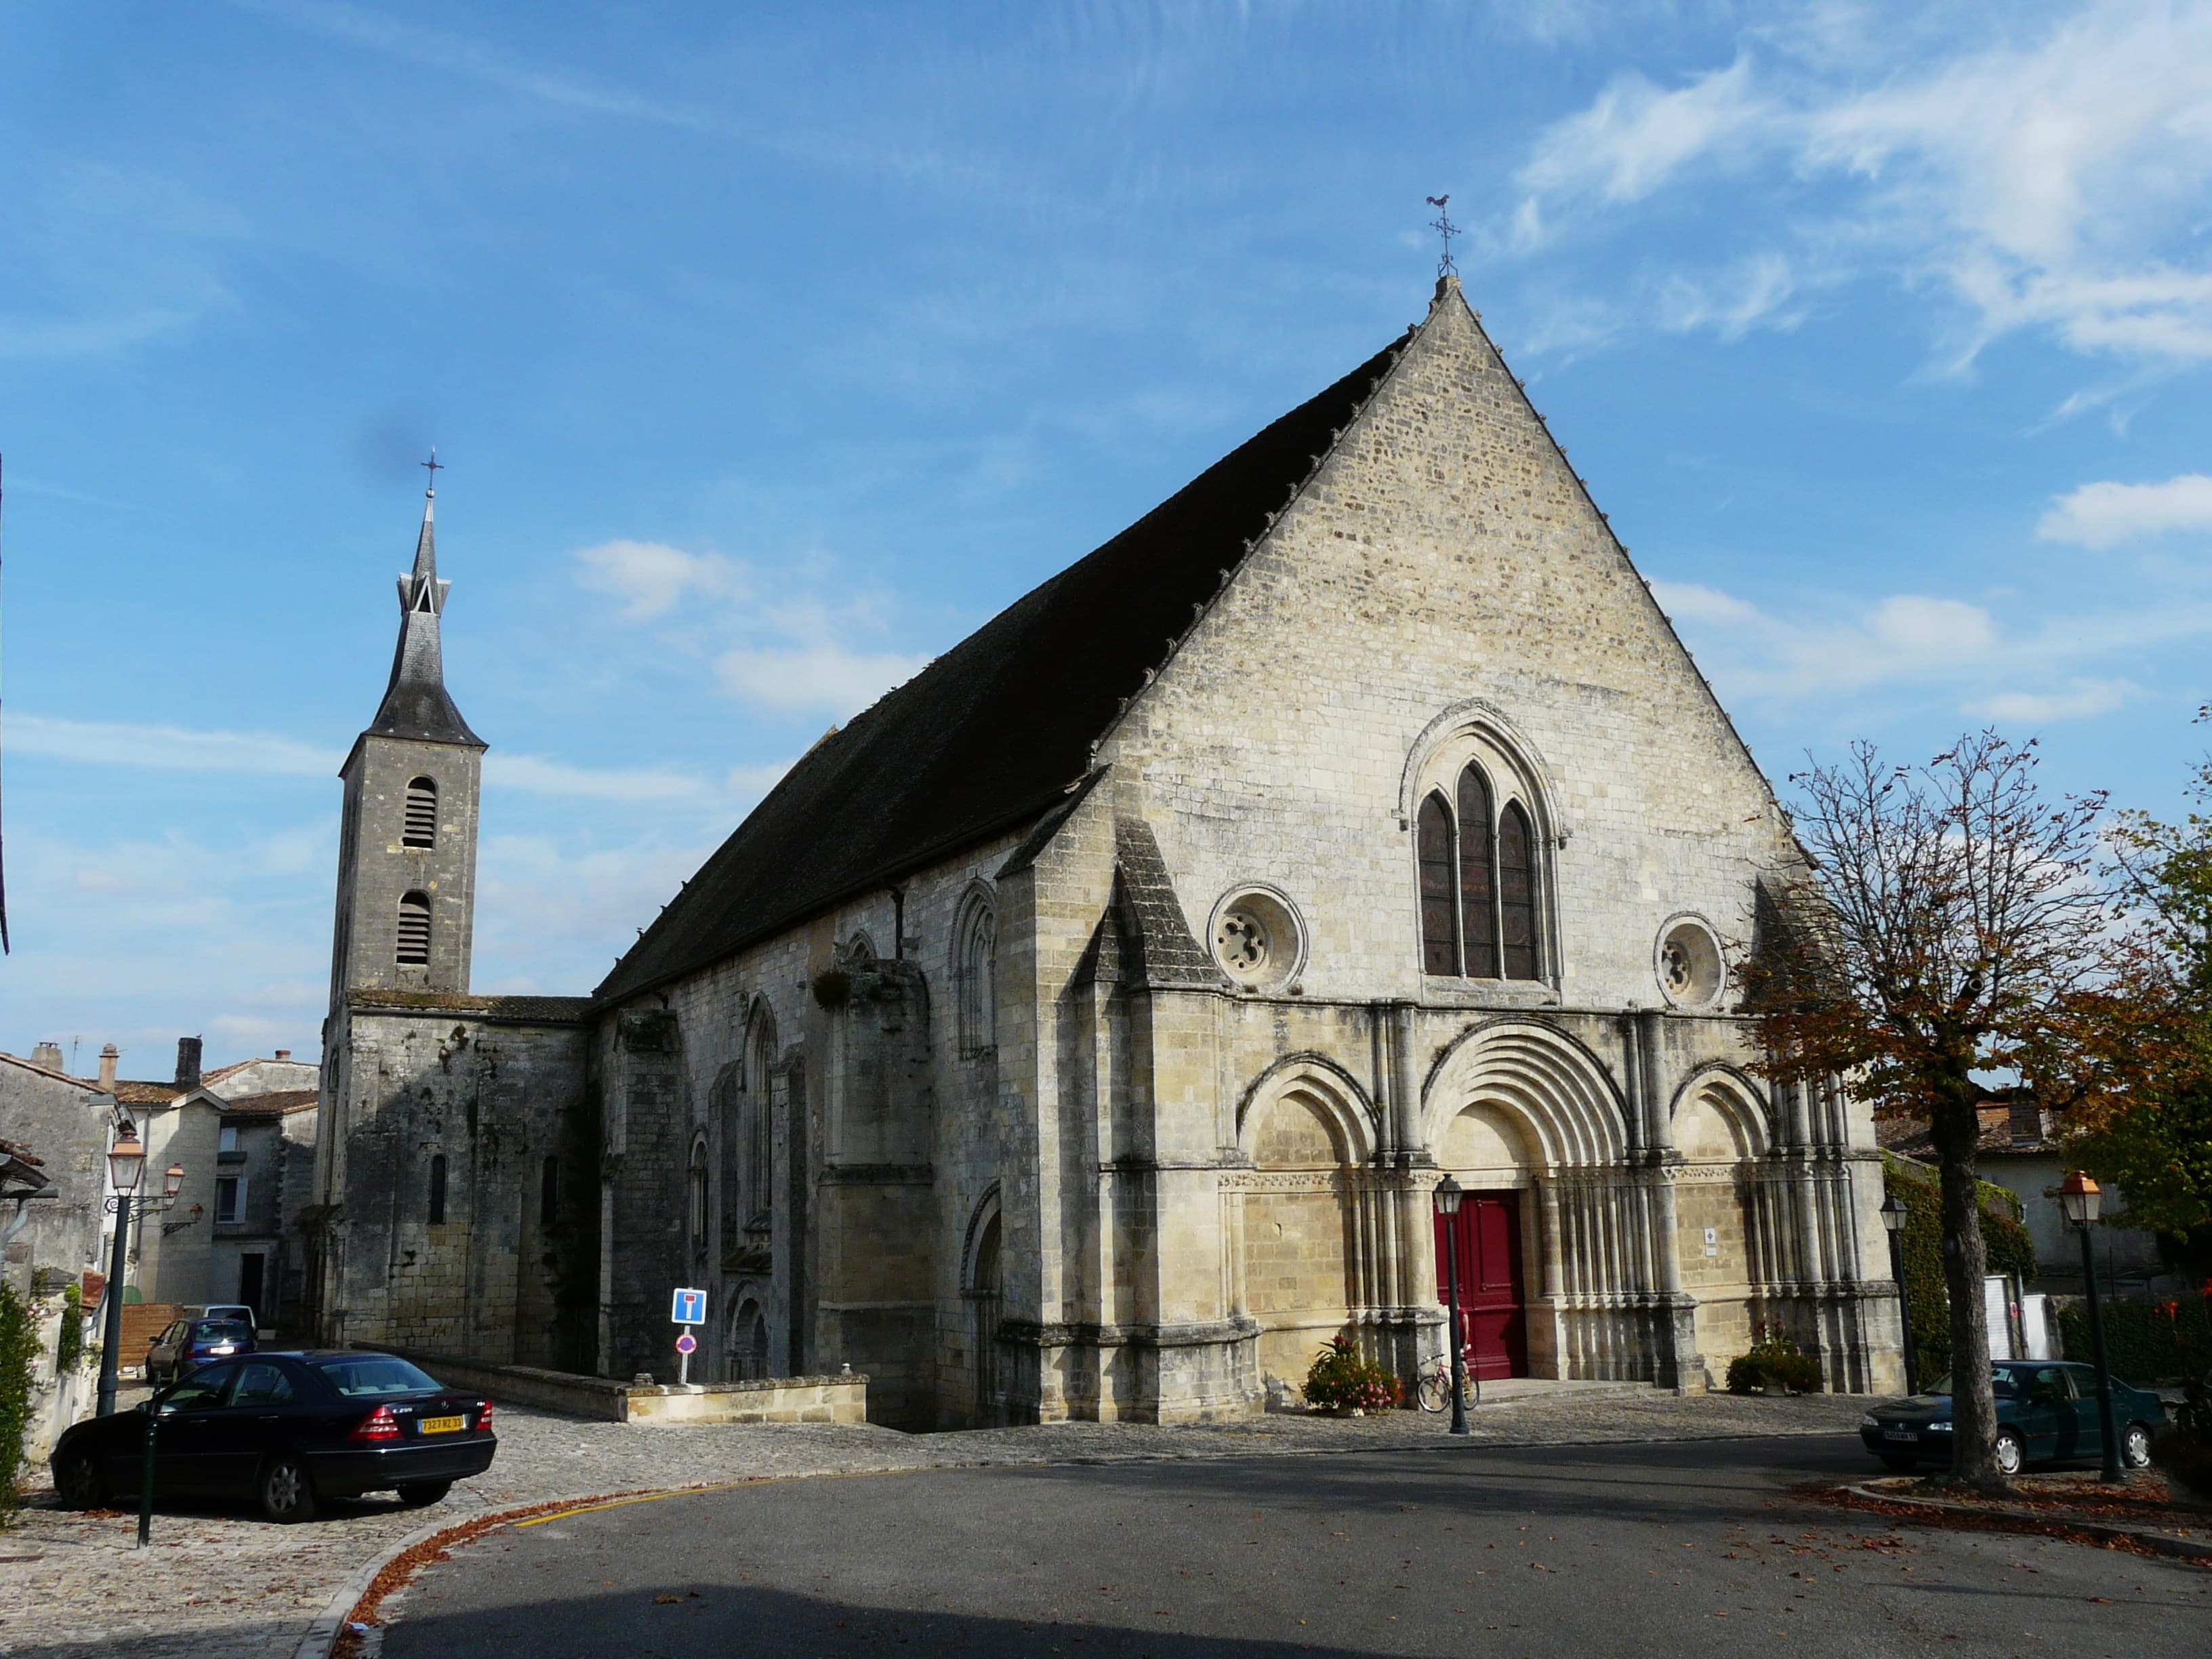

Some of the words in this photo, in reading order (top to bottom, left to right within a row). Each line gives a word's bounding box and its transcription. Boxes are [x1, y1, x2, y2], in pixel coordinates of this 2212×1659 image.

[422, 1419, 441, 1430] 7327
[443, 1418, 451, 1429] RZ
[453, 1417, 462, 1427] 33
